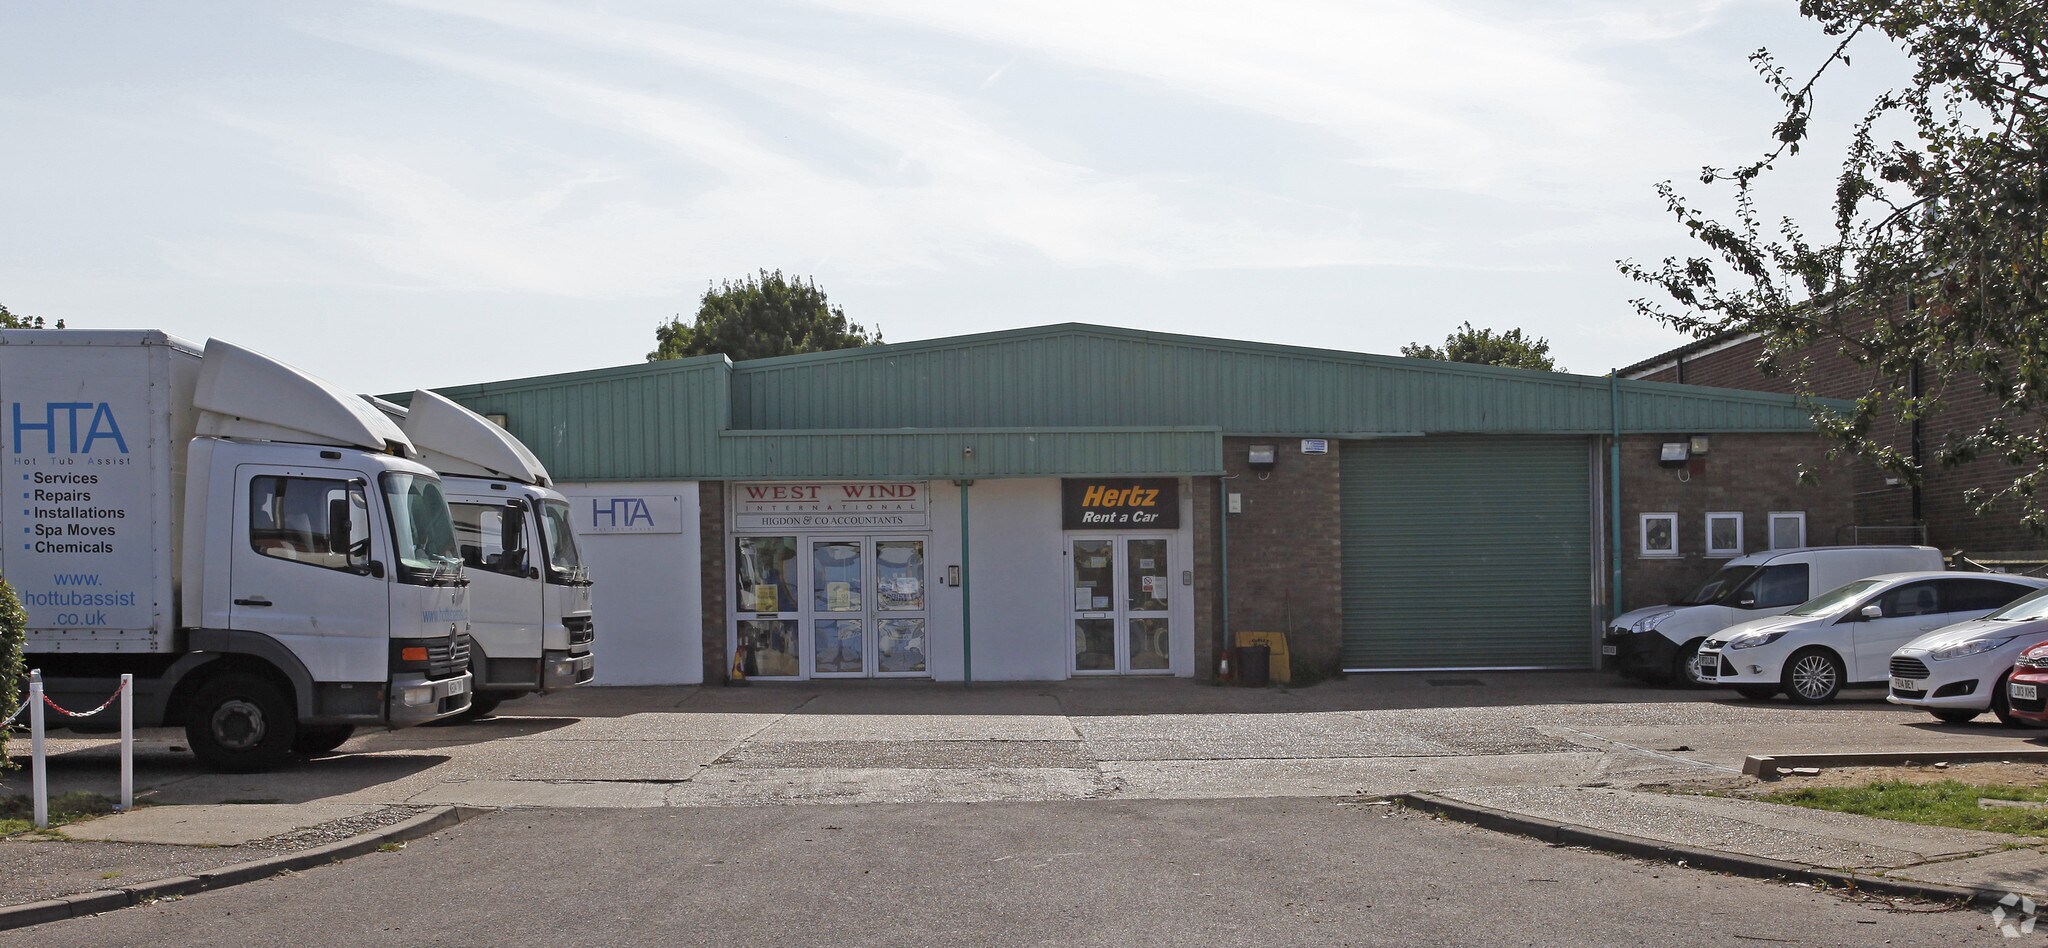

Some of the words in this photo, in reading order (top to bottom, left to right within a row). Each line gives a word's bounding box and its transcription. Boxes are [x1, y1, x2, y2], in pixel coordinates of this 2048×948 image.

[13, 402, 129, 454] HTA
[14, 457, 37, 466] Hot
[51, 457, 74, 466] Tub
[87, 457, 131, 465] Assist
[34, 471, 98, 484] Services
[34, 489, 91, 504] Repairs
[745, 485, 821, 499] WEST
[841, 484, 917, 498] WIND
[1081, 485, 1160, 507] Hertz
[34, 506, 125, 519] Installations
[592, 498, 655, 527] HTA
[1082, 511, 1116, 523] Rent
[1119, 513, 1129, 523] a
[1132, 510, 1159, 523] Car
[761, 517, 800, 526] HIGDON
[802, 515, 813, 526] &
[814, 517, 829, 526] CO
[830, 516, 903, 525] ACCOUNTANTS
[34, 523, 63, 539] Spa
[67, 523, 116, 537] Moves
[35, 540, 114, 554] Chemicals
[53, 573, 103, 586] www.
[25, 590, 136, 606] hottubassist
[52, 609, 107, 626] .co.uk
